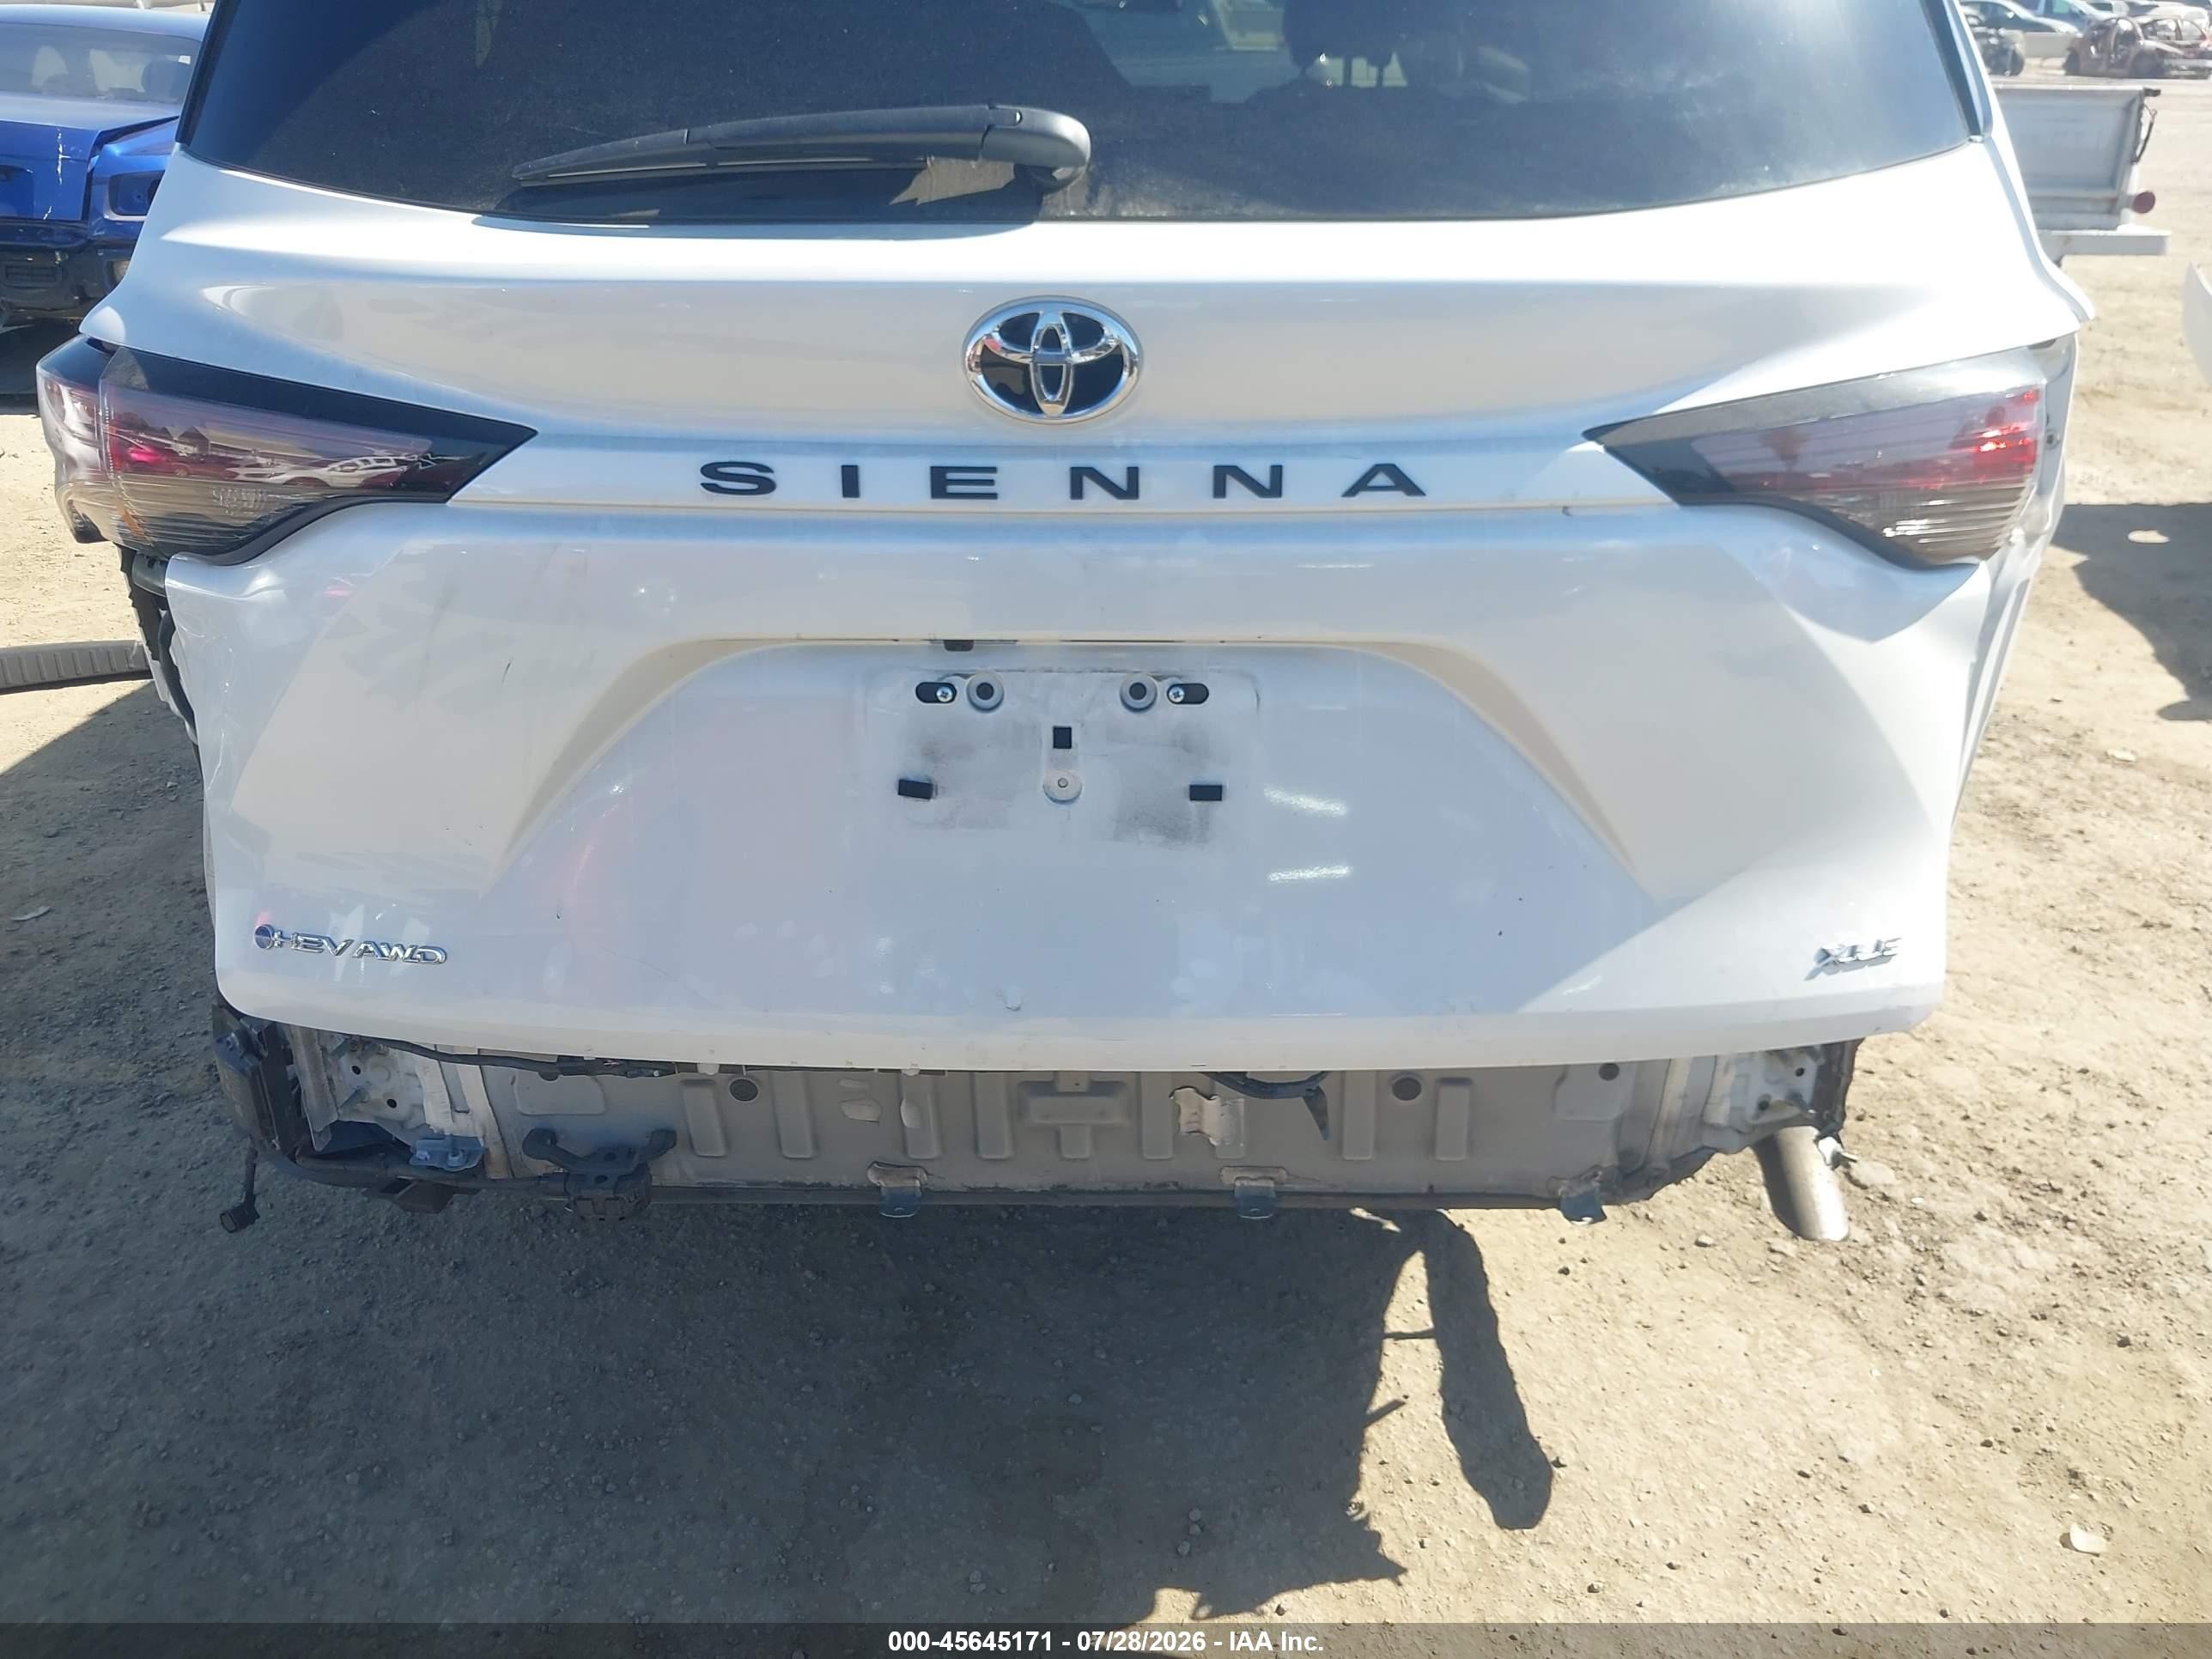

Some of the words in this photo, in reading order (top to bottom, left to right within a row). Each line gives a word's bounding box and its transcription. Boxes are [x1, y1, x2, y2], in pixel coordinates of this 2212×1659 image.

[700, 461, 1427, 500] SIENNA
[273, 930, 354, 957] HEV
[351, 940, 447, 964] AWD
[1813, 937, 1902, 969] XLE
